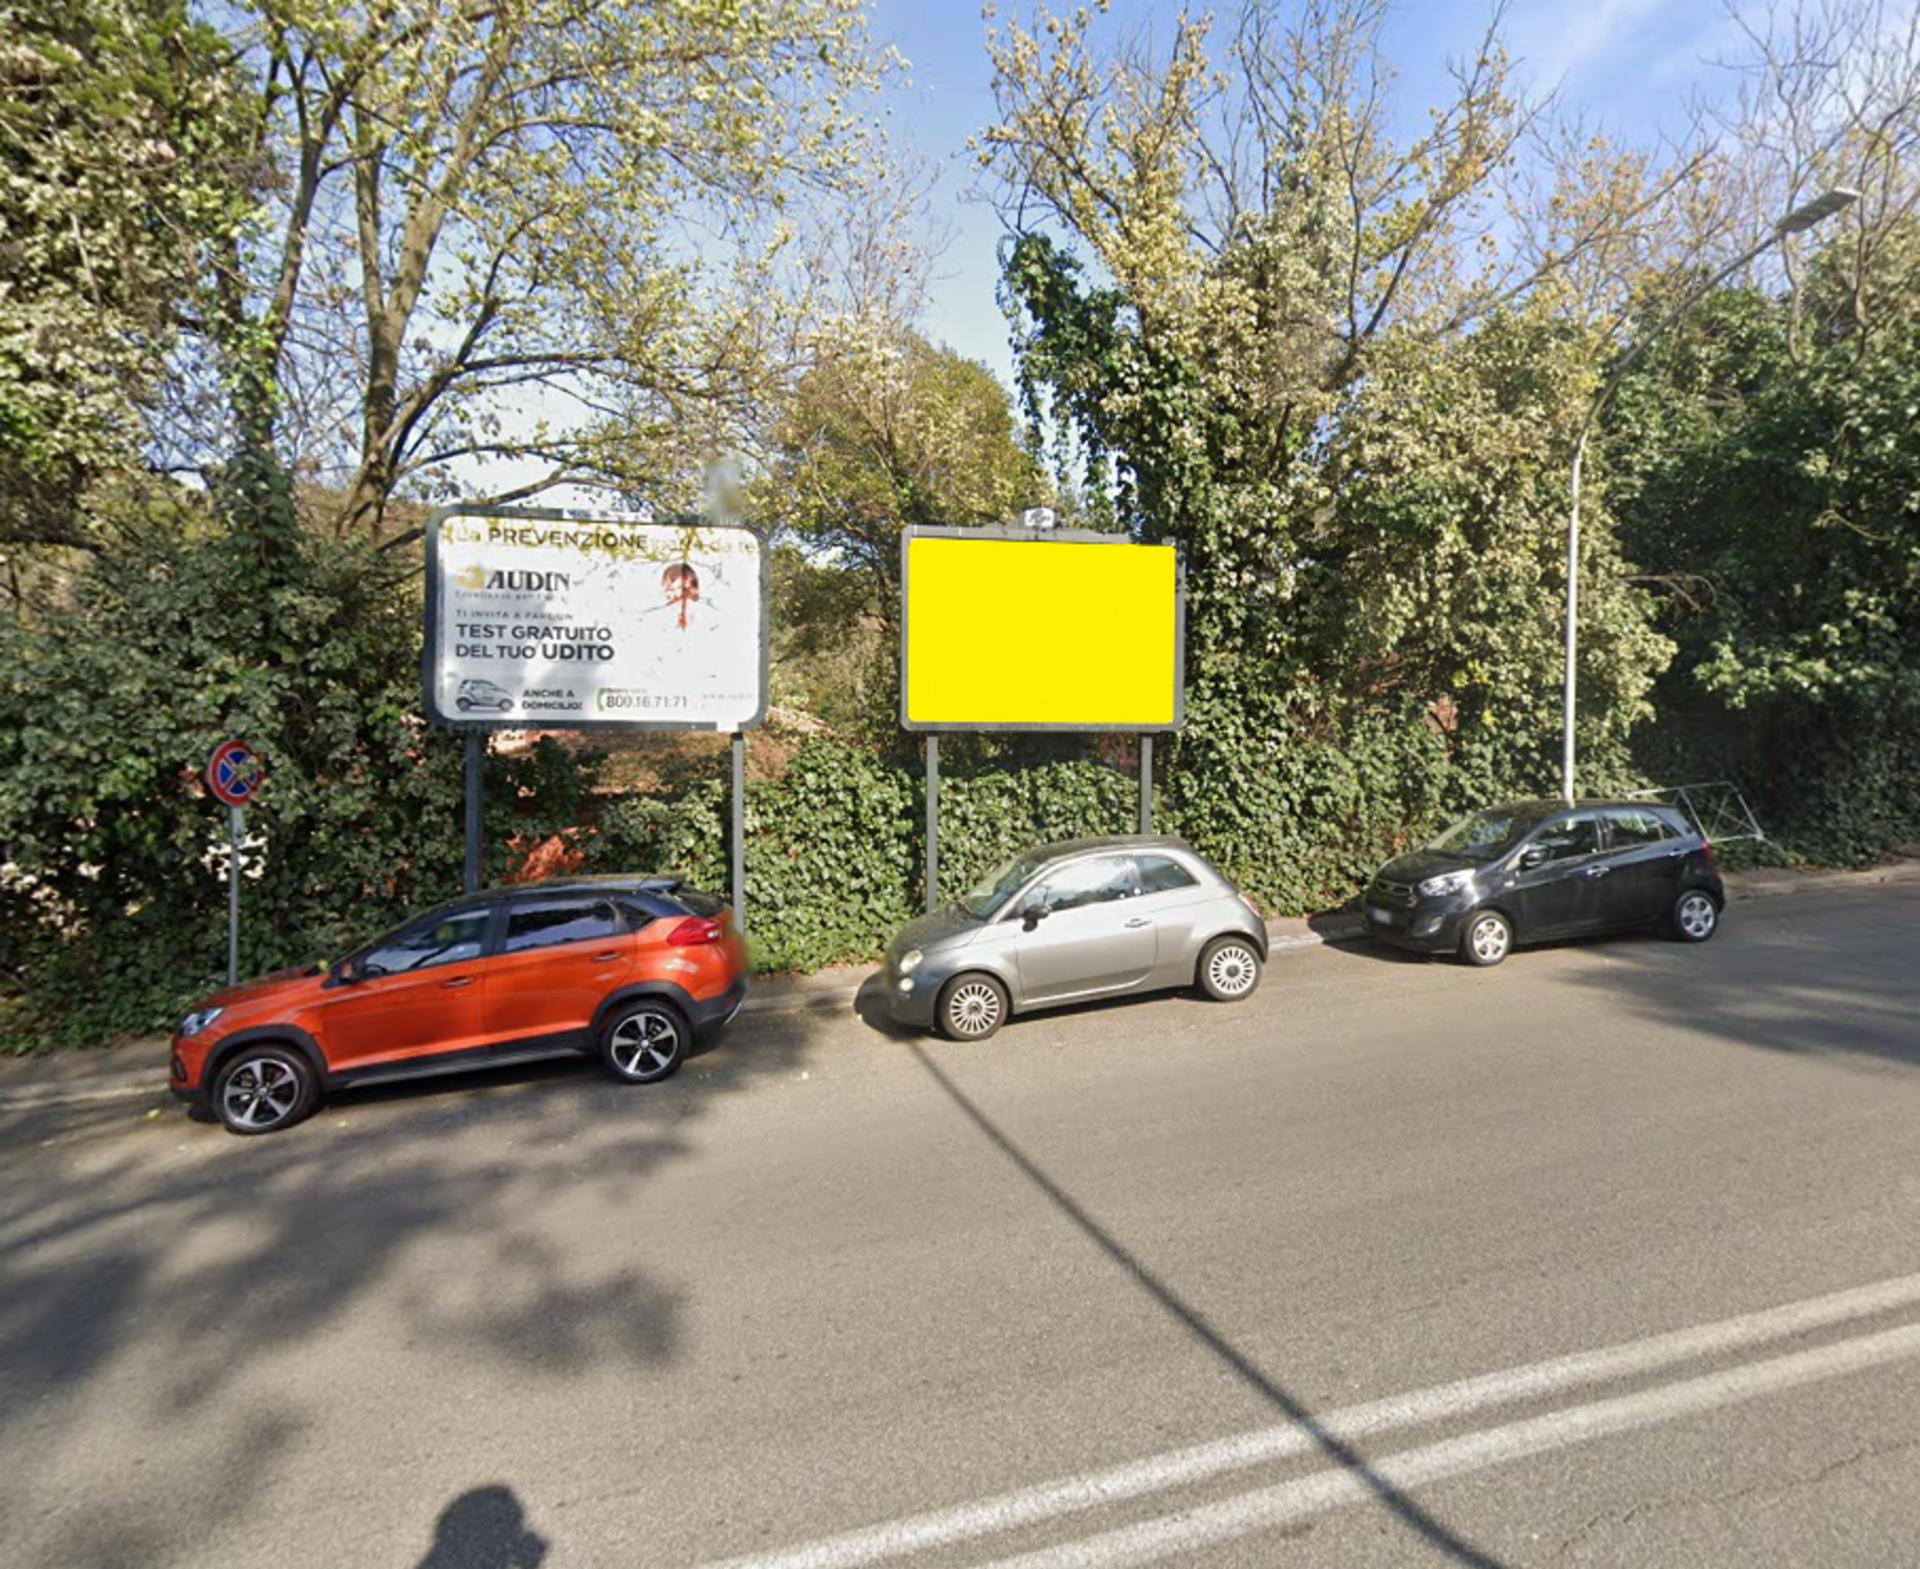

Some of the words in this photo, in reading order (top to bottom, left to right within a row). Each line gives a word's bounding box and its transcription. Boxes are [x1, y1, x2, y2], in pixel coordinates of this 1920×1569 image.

[488, 526, 648, 548] PREVENZIONE
[485, 570, 570, 593] AUDIN
[456, 608, 467, 617] TI
[470, 609, 509, 618] INVITA
[513, 611, 523, 619] A
[456, 623, 507, 639] TEST
[512, 625, 613, 642] GRATUITO
[455, 643, 493, 658] DEL
[496, 645, 537, 660] TUO
[541, 643, 616, 661] UDITO
[523, 688, 564, 698] ANCHE
[566, 689, 575, 698] A
[606, 695, 688, 709] 800.16.71.71
